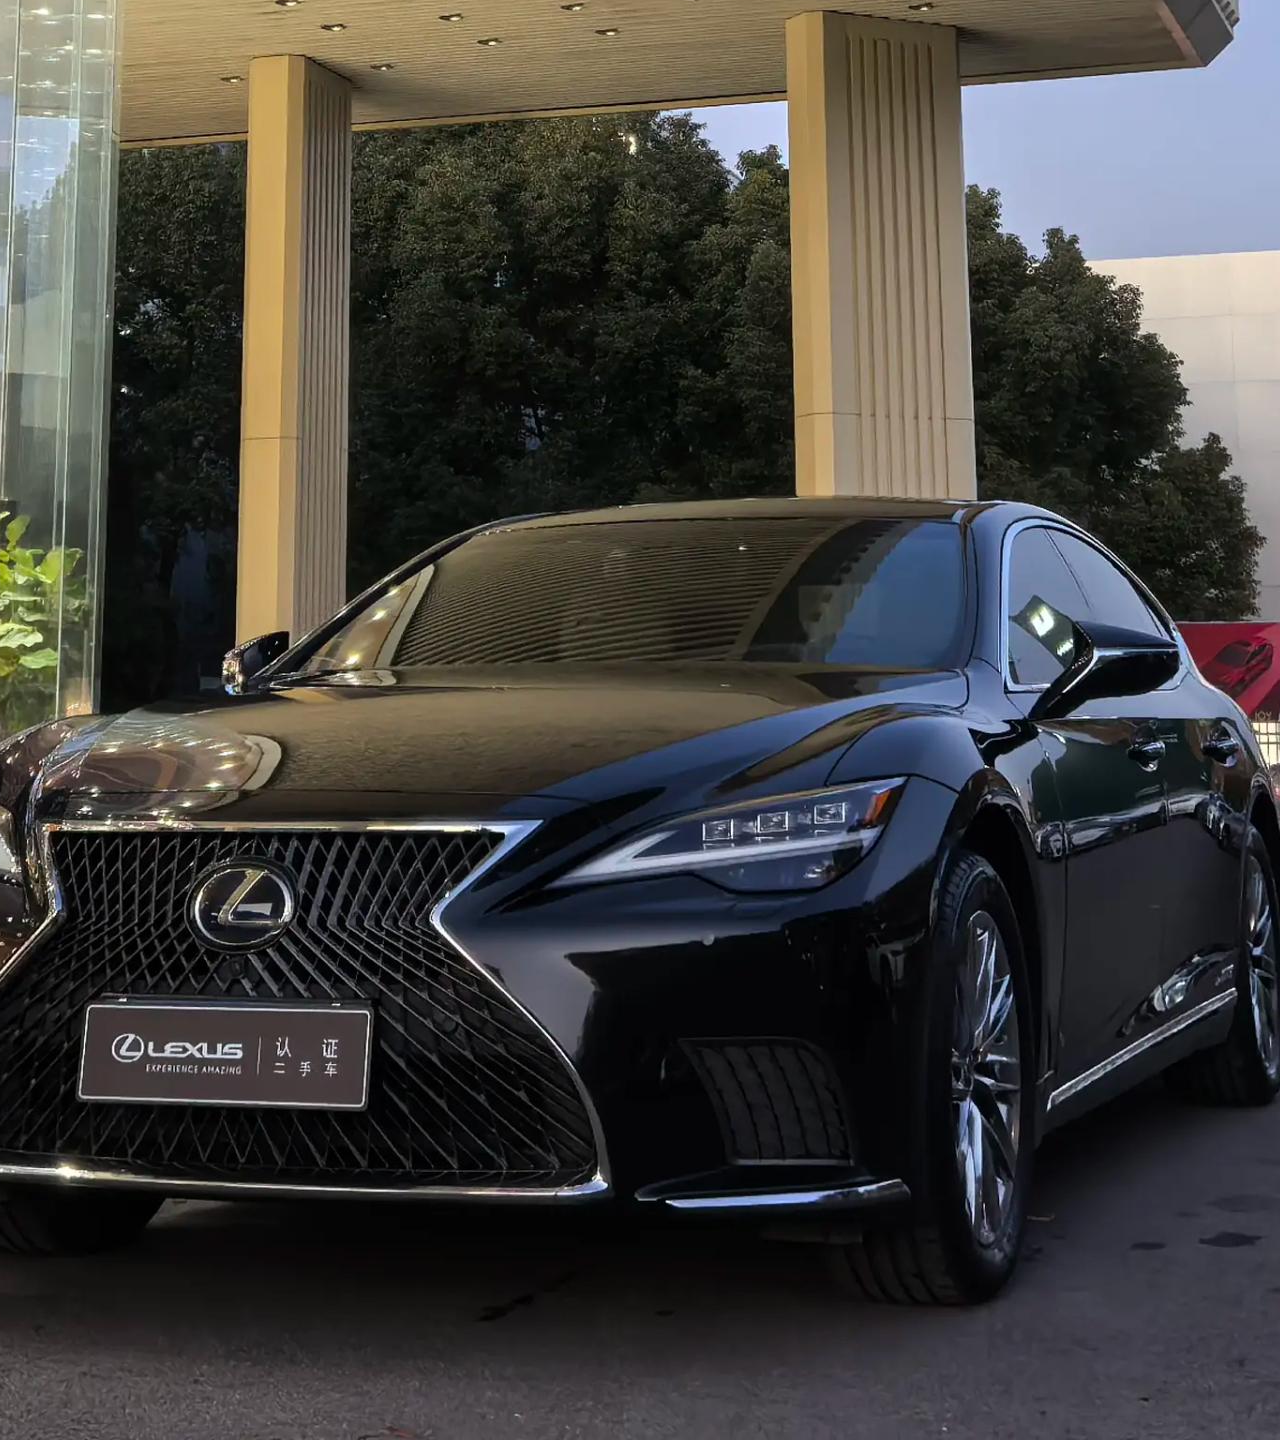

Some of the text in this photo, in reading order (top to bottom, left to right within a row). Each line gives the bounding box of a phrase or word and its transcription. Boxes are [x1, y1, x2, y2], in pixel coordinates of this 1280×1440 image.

[148, 1041, 243, 1059] LEXUS
[146, 1063, 242, 1075] EXPERIENCE AMAZING
